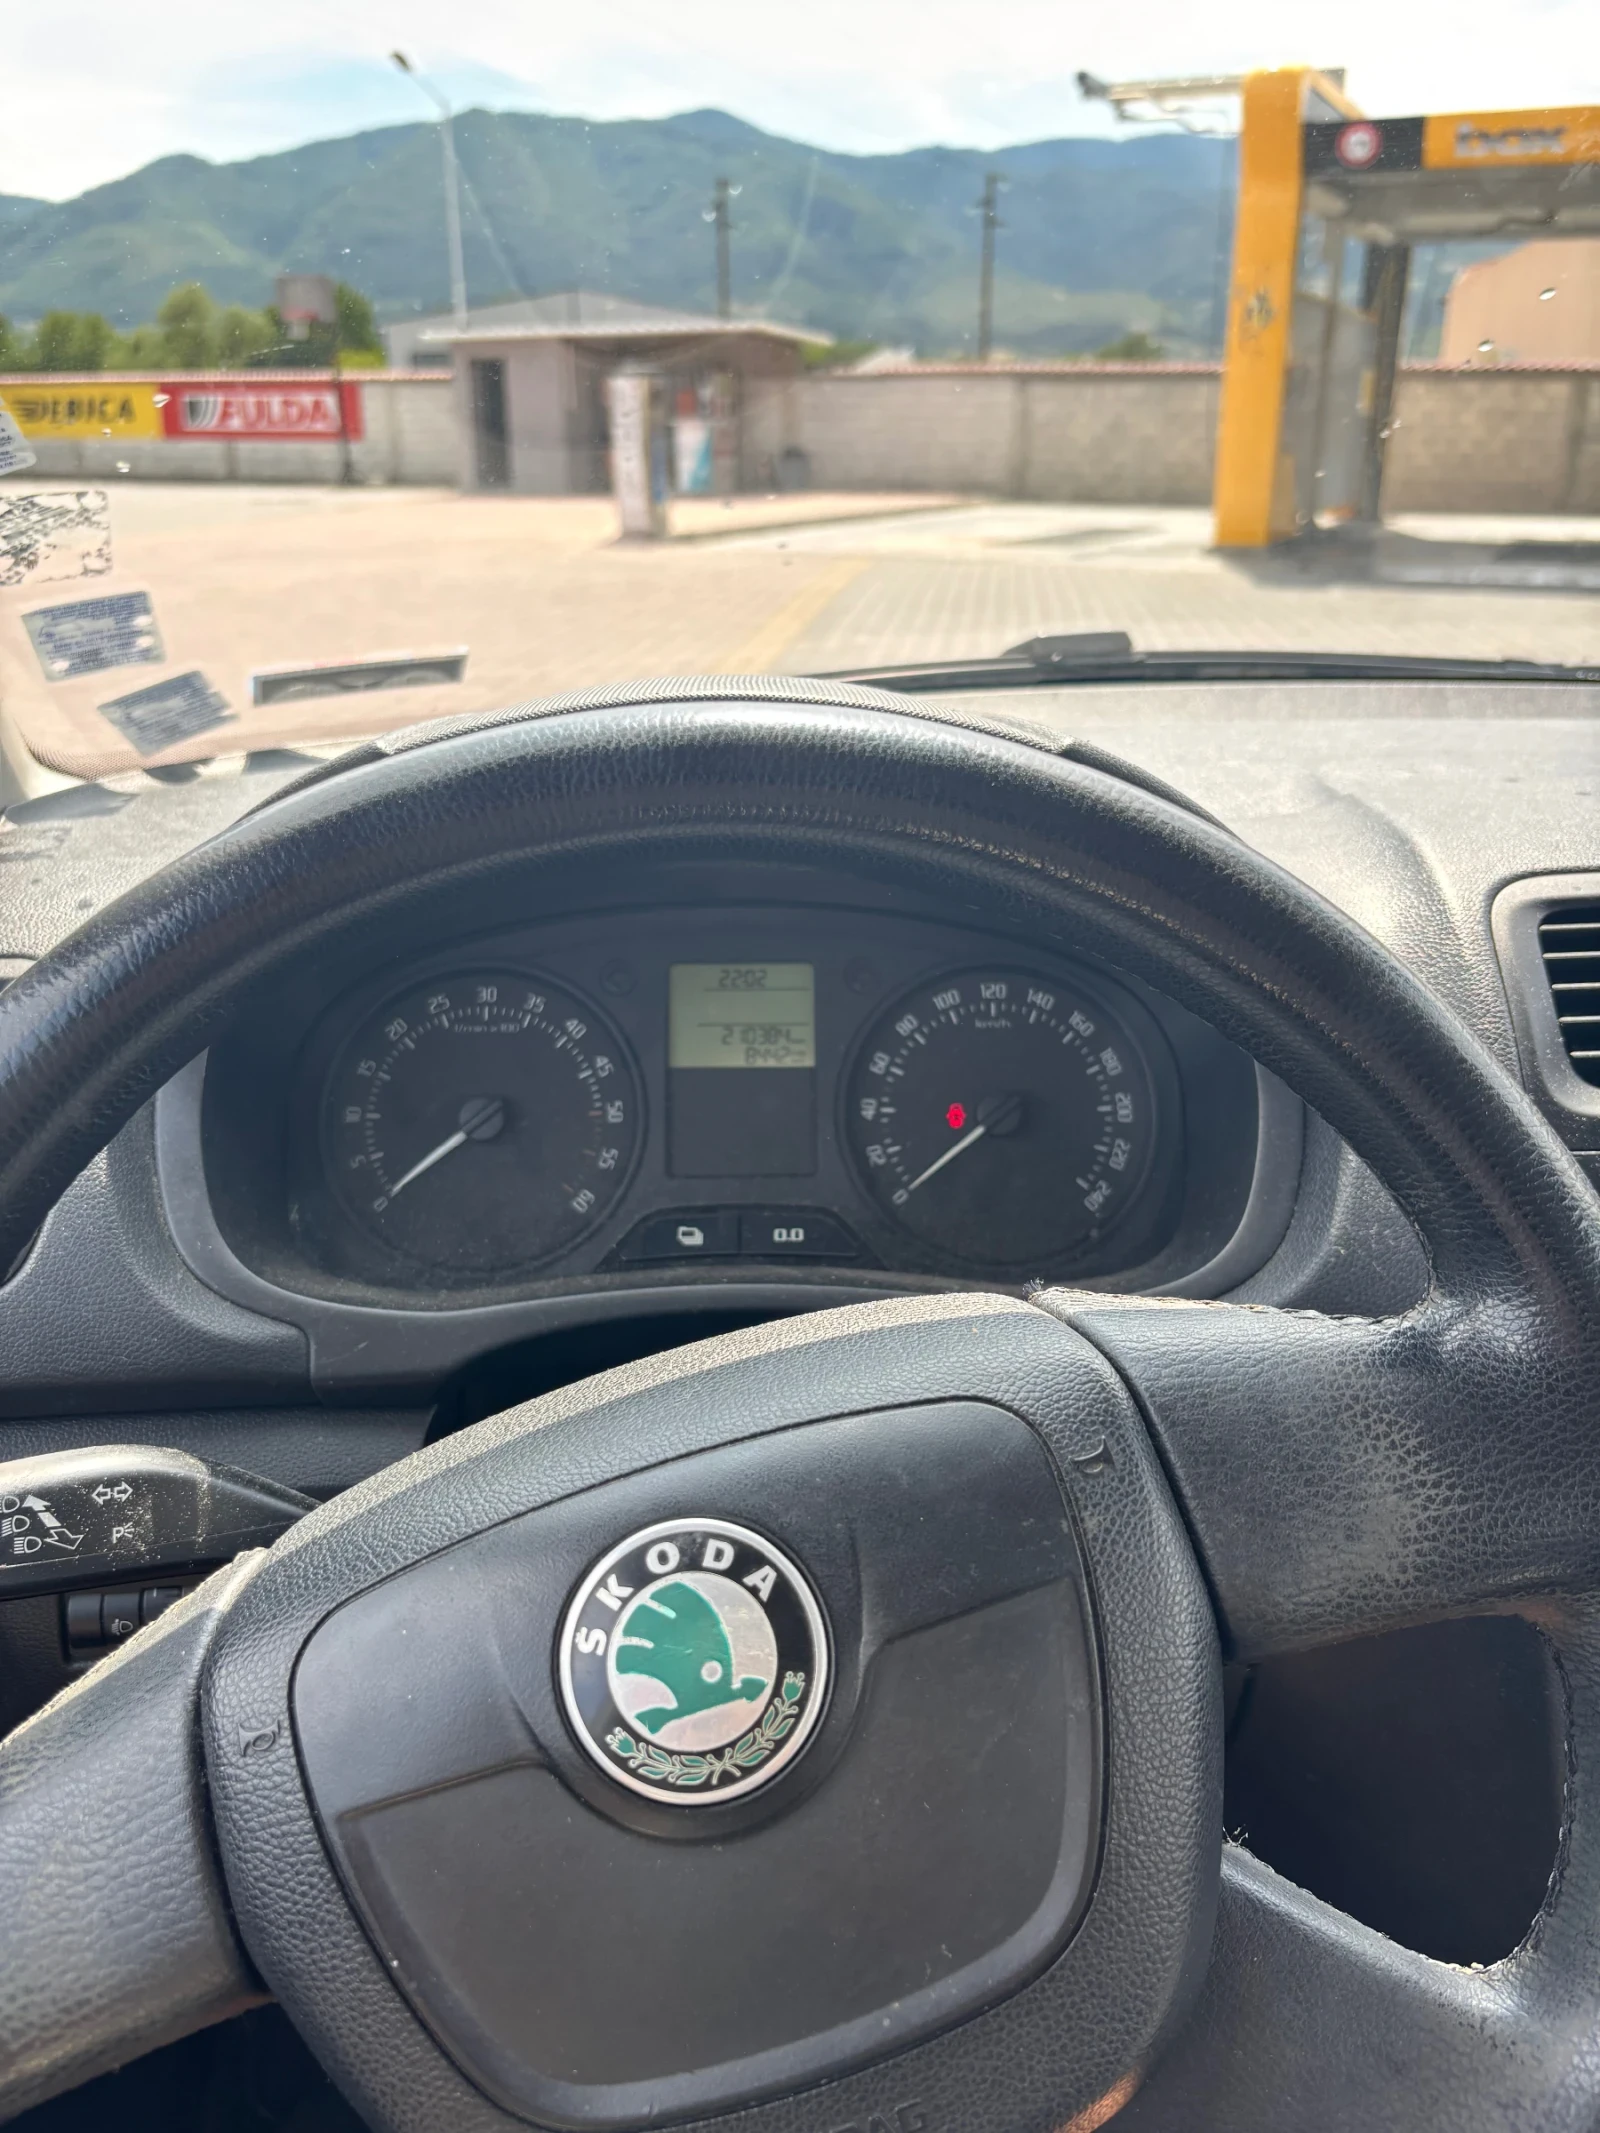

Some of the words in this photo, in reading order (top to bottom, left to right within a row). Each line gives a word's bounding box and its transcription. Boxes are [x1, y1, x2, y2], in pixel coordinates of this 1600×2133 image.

[476, 986, 497, 1002] 30
[523, 992, 546, 1013] 35
[932, 989, 961, 1011] 100
[980, 983, 1007, 1000] 120
[1027, 988, 1055, 1011] 140
[428, 993, 451, 1014] 25
[385, 1017, 408, 1041] 20
[564, 1018, 587, 1039] 40
[895, 1014, 919, 1036] 80
[1068, 1010, 1095, 1037] 160
[356, 1059, 377, 1077] 15
[595, 1055, 614, 1078] 45
[869, 1052, 890, 1075] 60
[1100, 1047, 1122, 1077] 180
[345, 1106, 362, 1123] 10
[607, 1100, 624, 1123] 50
[860, 1098, 877, 1121] 40
[1115, 1092, 1133, 1123] 200
[350, 1154, 367, 1169] 5
[598, 1148, 619, 1170] 55
[865, 1145, 887, 1167] 20
[1109, 1138, 1131, 1171] 220
[373, 1196, 389, 1213] 0
[571, 1189, 596, 1214] 60
[892, 1189, 909, 1205] 0
[1084, 1180, 1111, 1211] 240
